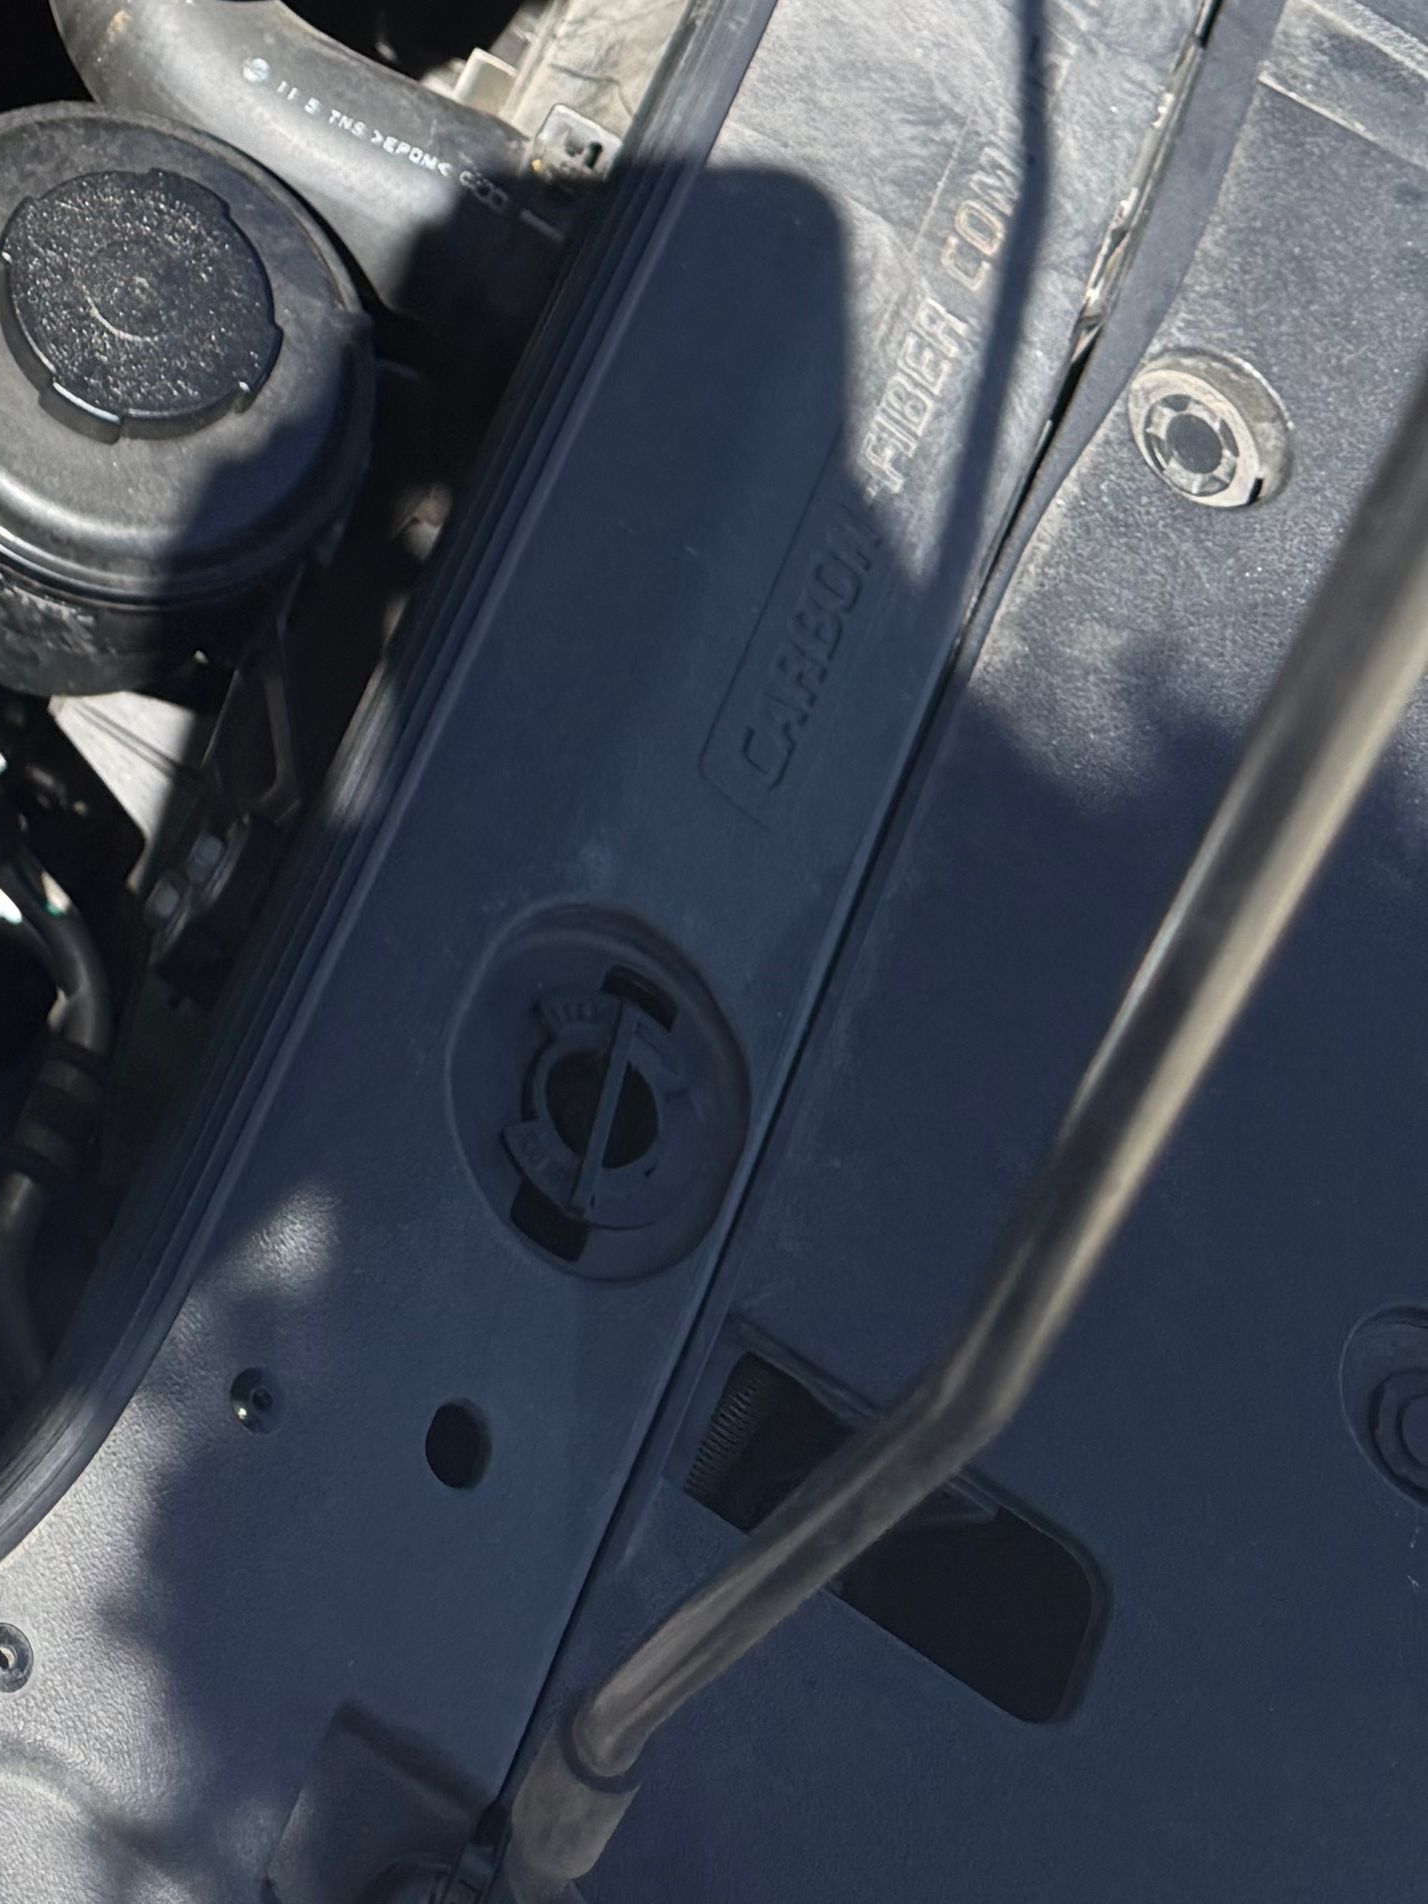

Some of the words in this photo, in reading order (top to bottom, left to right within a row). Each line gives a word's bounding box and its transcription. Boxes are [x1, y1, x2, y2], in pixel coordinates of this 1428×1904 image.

[328, 109, 366, 137] TNS
[741, 501, 883, 792] CARBON
[858, 297, 969, 496] FIBER
